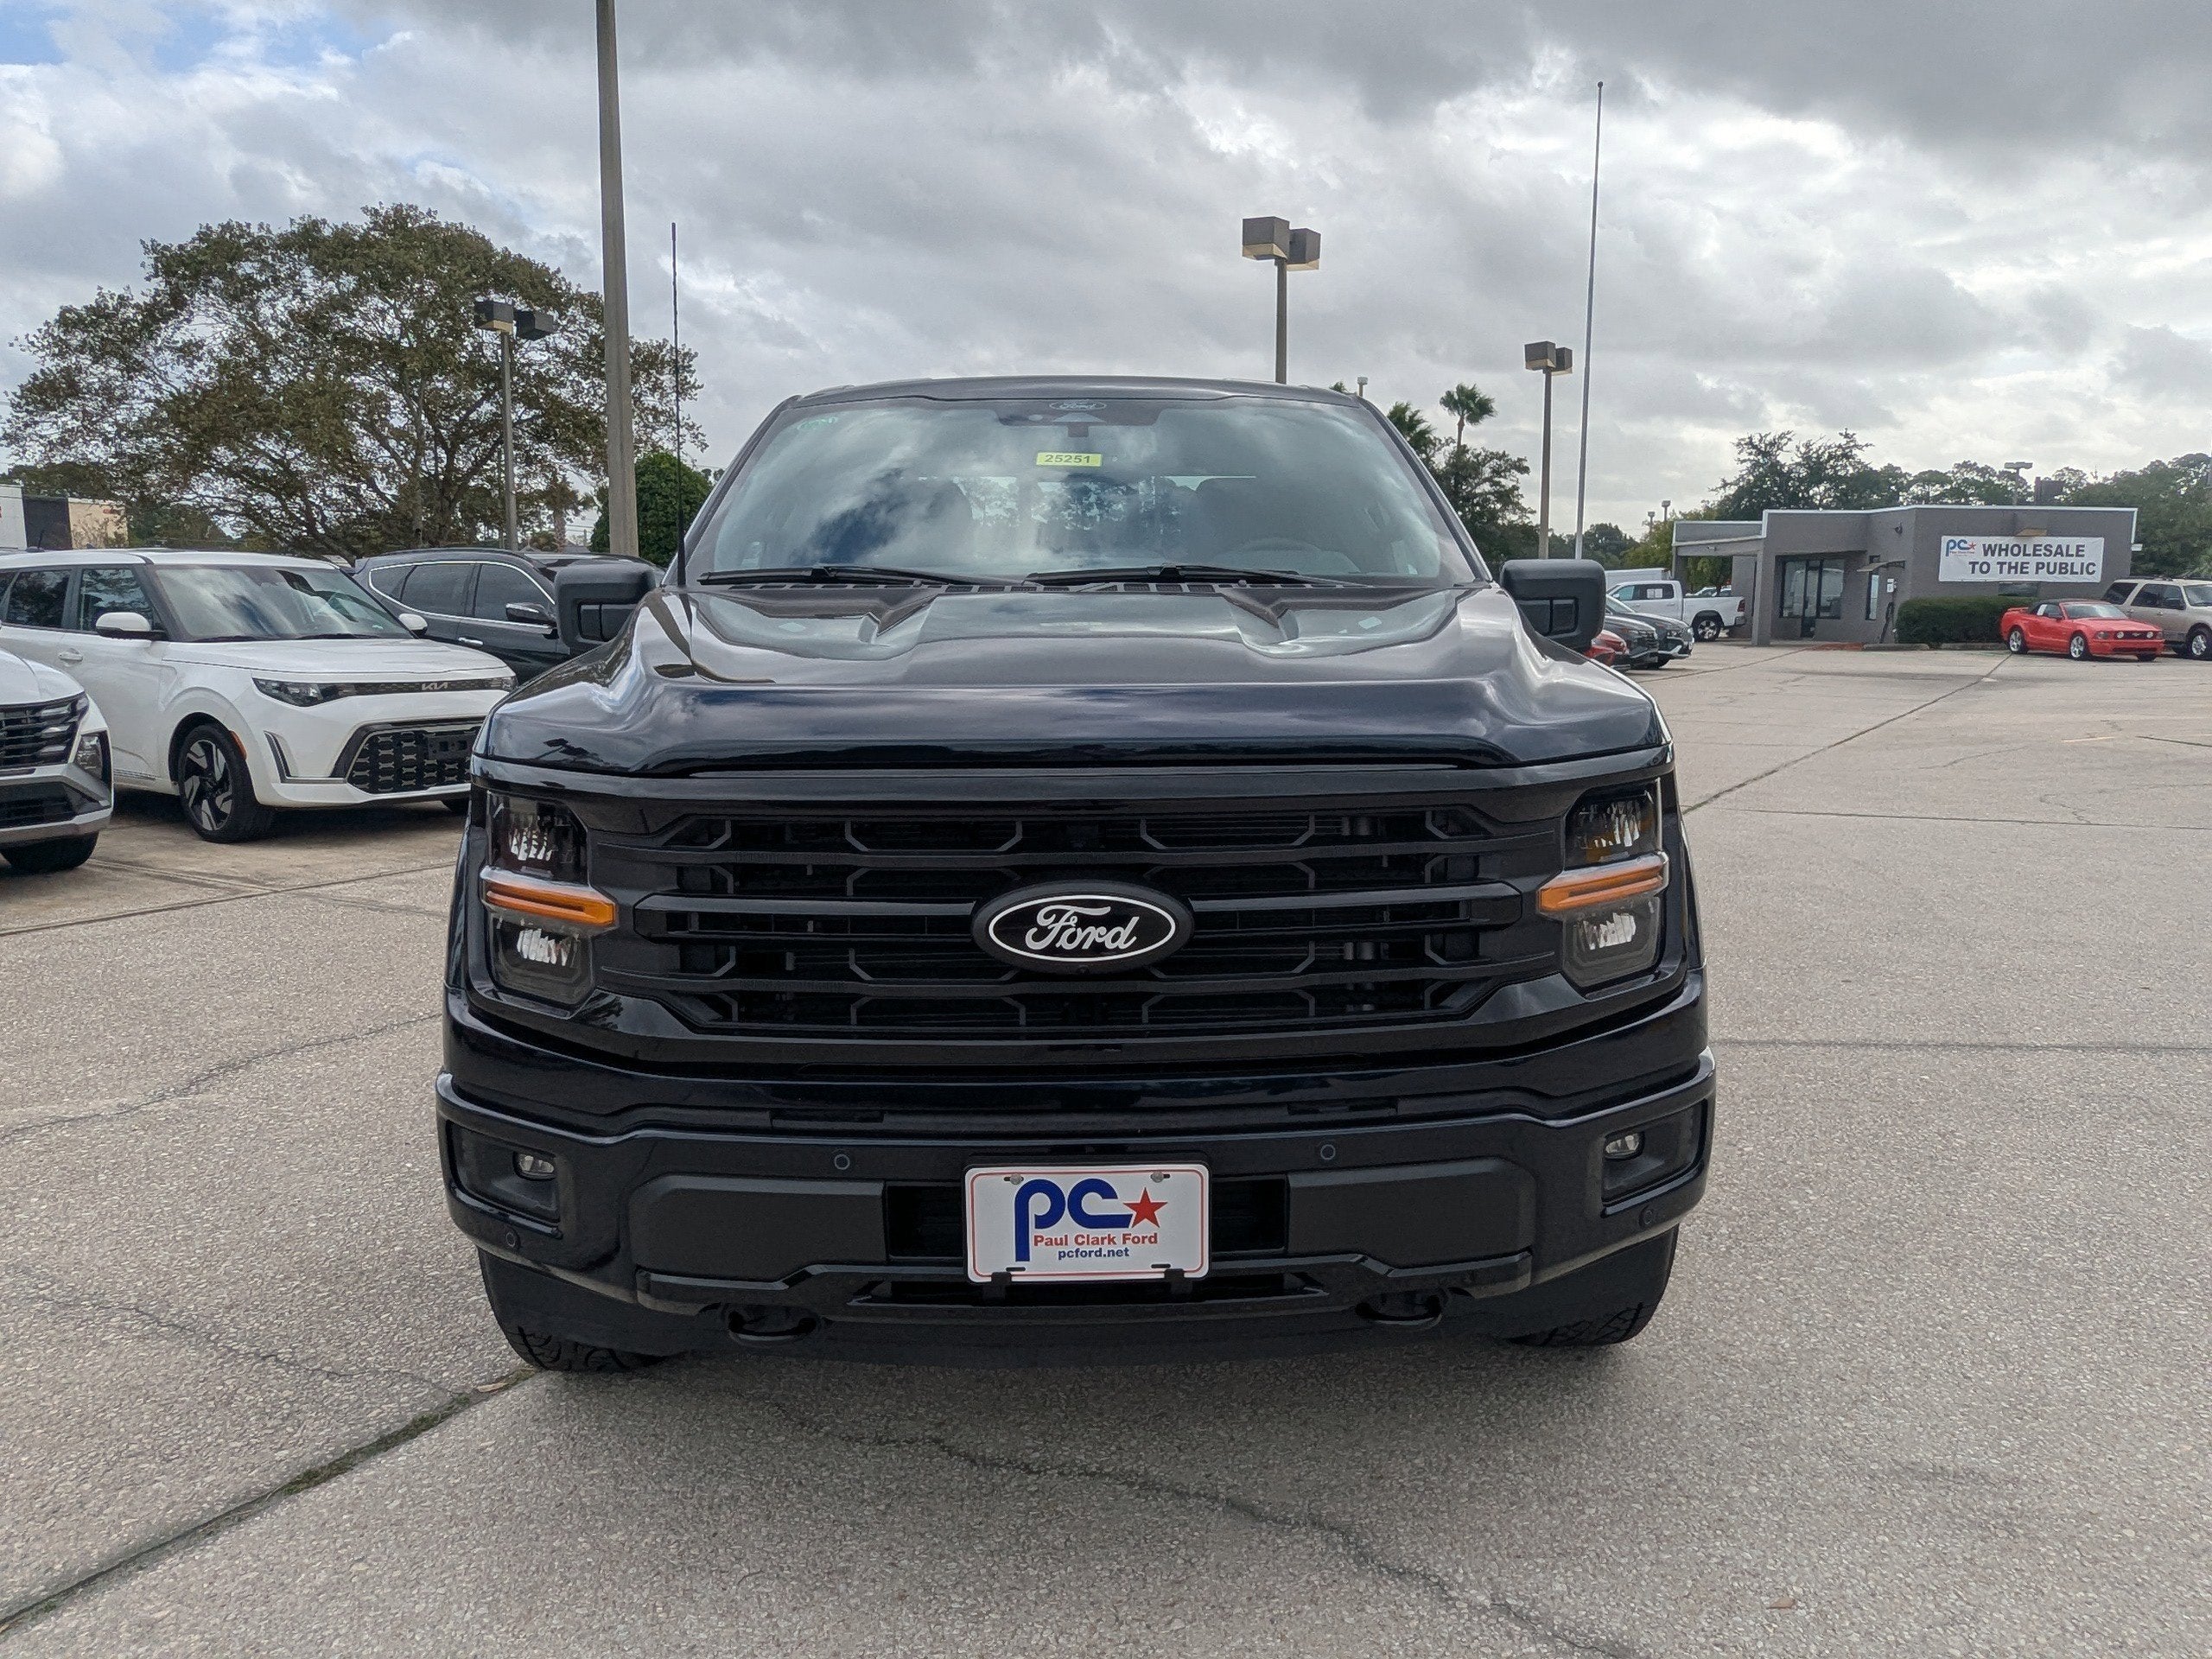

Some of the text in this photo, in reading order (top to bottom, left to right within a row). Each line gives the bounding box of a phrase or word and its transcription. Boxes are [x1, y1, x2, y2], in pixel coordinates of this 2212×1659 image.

[1045, 454, 1090, 464] 25251
[1982, 543, 2085, 557] WHOLESALE
[1969, 562, 2096, 575] TO THE PUBLIC
[1025, 905, 1140, 950] Ford
[1033, 1232, 1158, 1247] Paul Clark Ford
[1058, 1247, 1129, 1260] pcford.net
